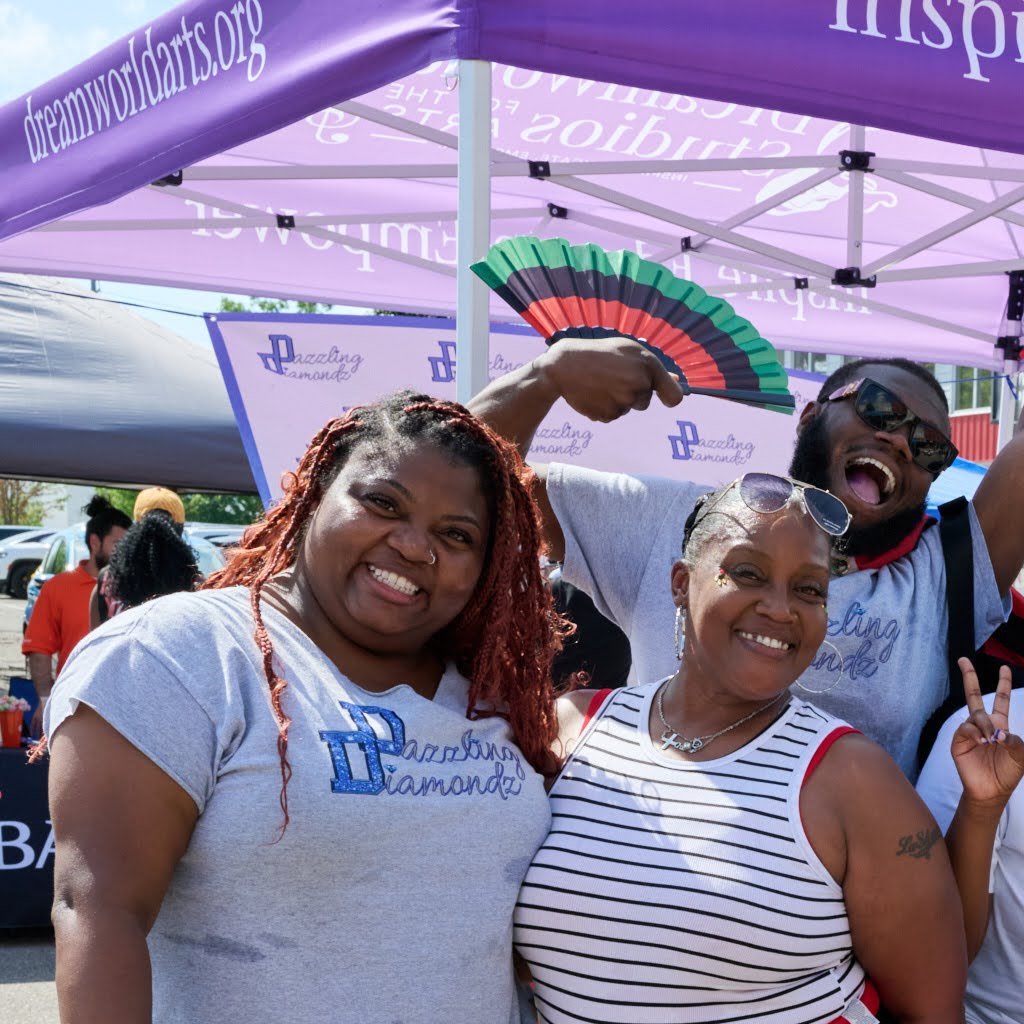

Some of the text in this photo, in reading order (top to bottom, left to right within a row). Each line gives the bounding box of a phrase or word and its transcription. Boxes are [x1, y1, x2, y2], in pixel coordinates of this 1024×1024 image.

[24, 0, 266, 163] dreamworldarts.org
[319, 730, 522, 800] Diamondz
[339, 701, 526, 781] Dazzling
